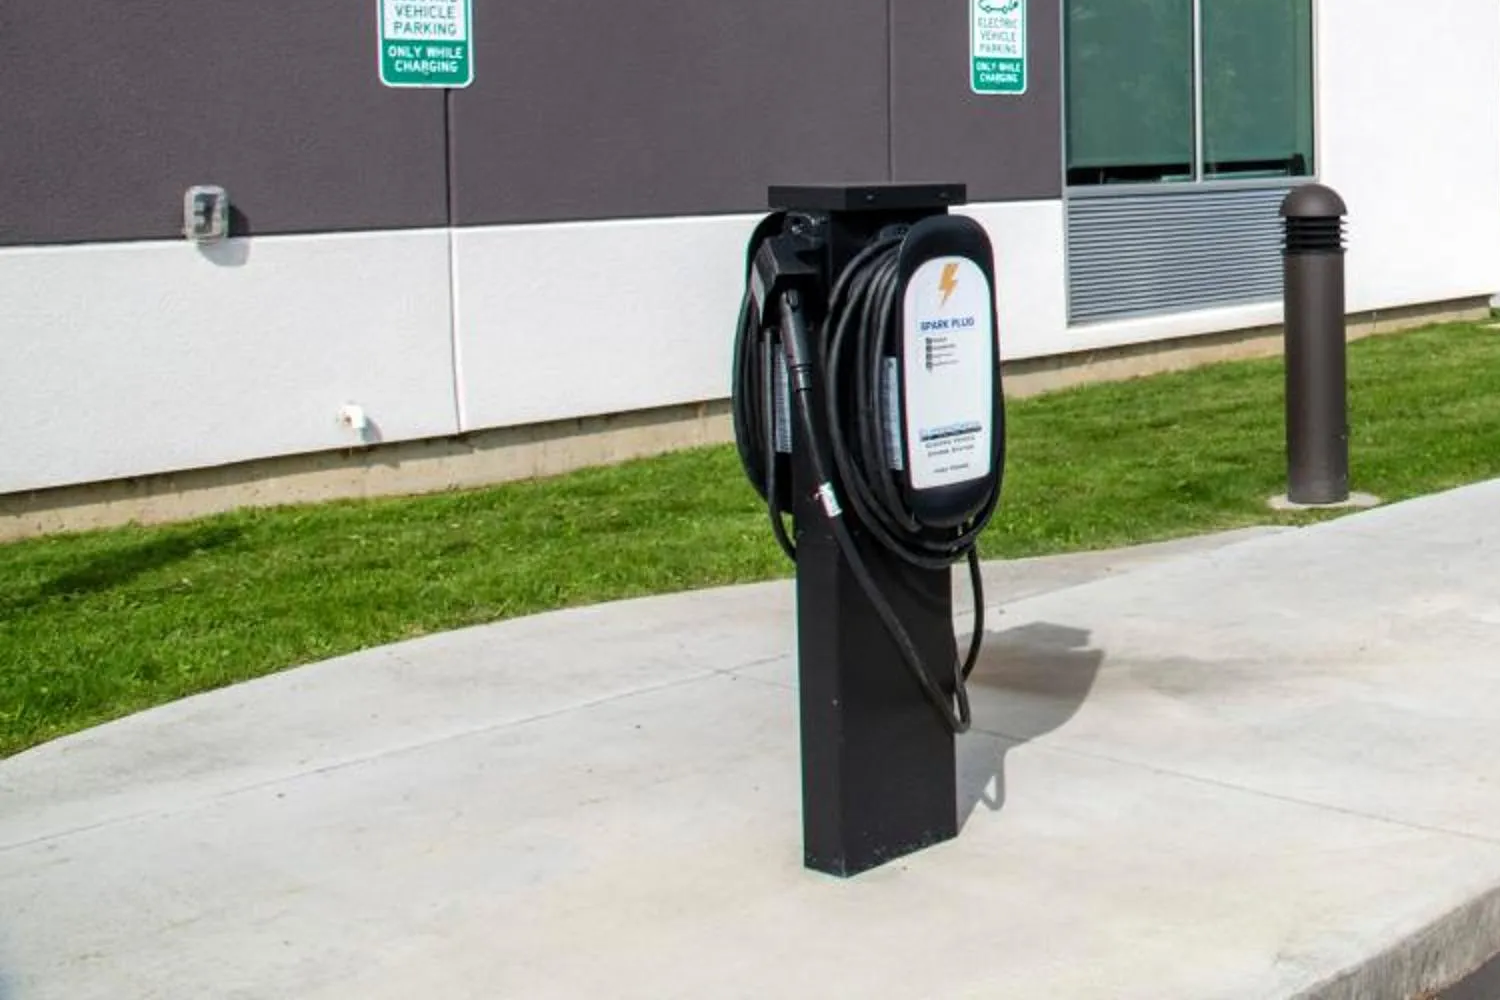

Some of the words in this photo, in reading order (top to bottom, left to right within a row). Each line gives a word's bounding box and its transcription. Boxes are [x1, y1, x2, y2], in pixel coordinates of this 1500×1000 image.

[394, 5, 457, 19] VEHICLE
[393, 22, 457, 36] PARKING
[388, 45, 422, 58] ONLY
[426, 46, 463, 59] WHILE
[395, 60, 458, 74] CHARGING
[920, 319, 950, 331] SPARK
[951, 316, 975, 328] PLUG
